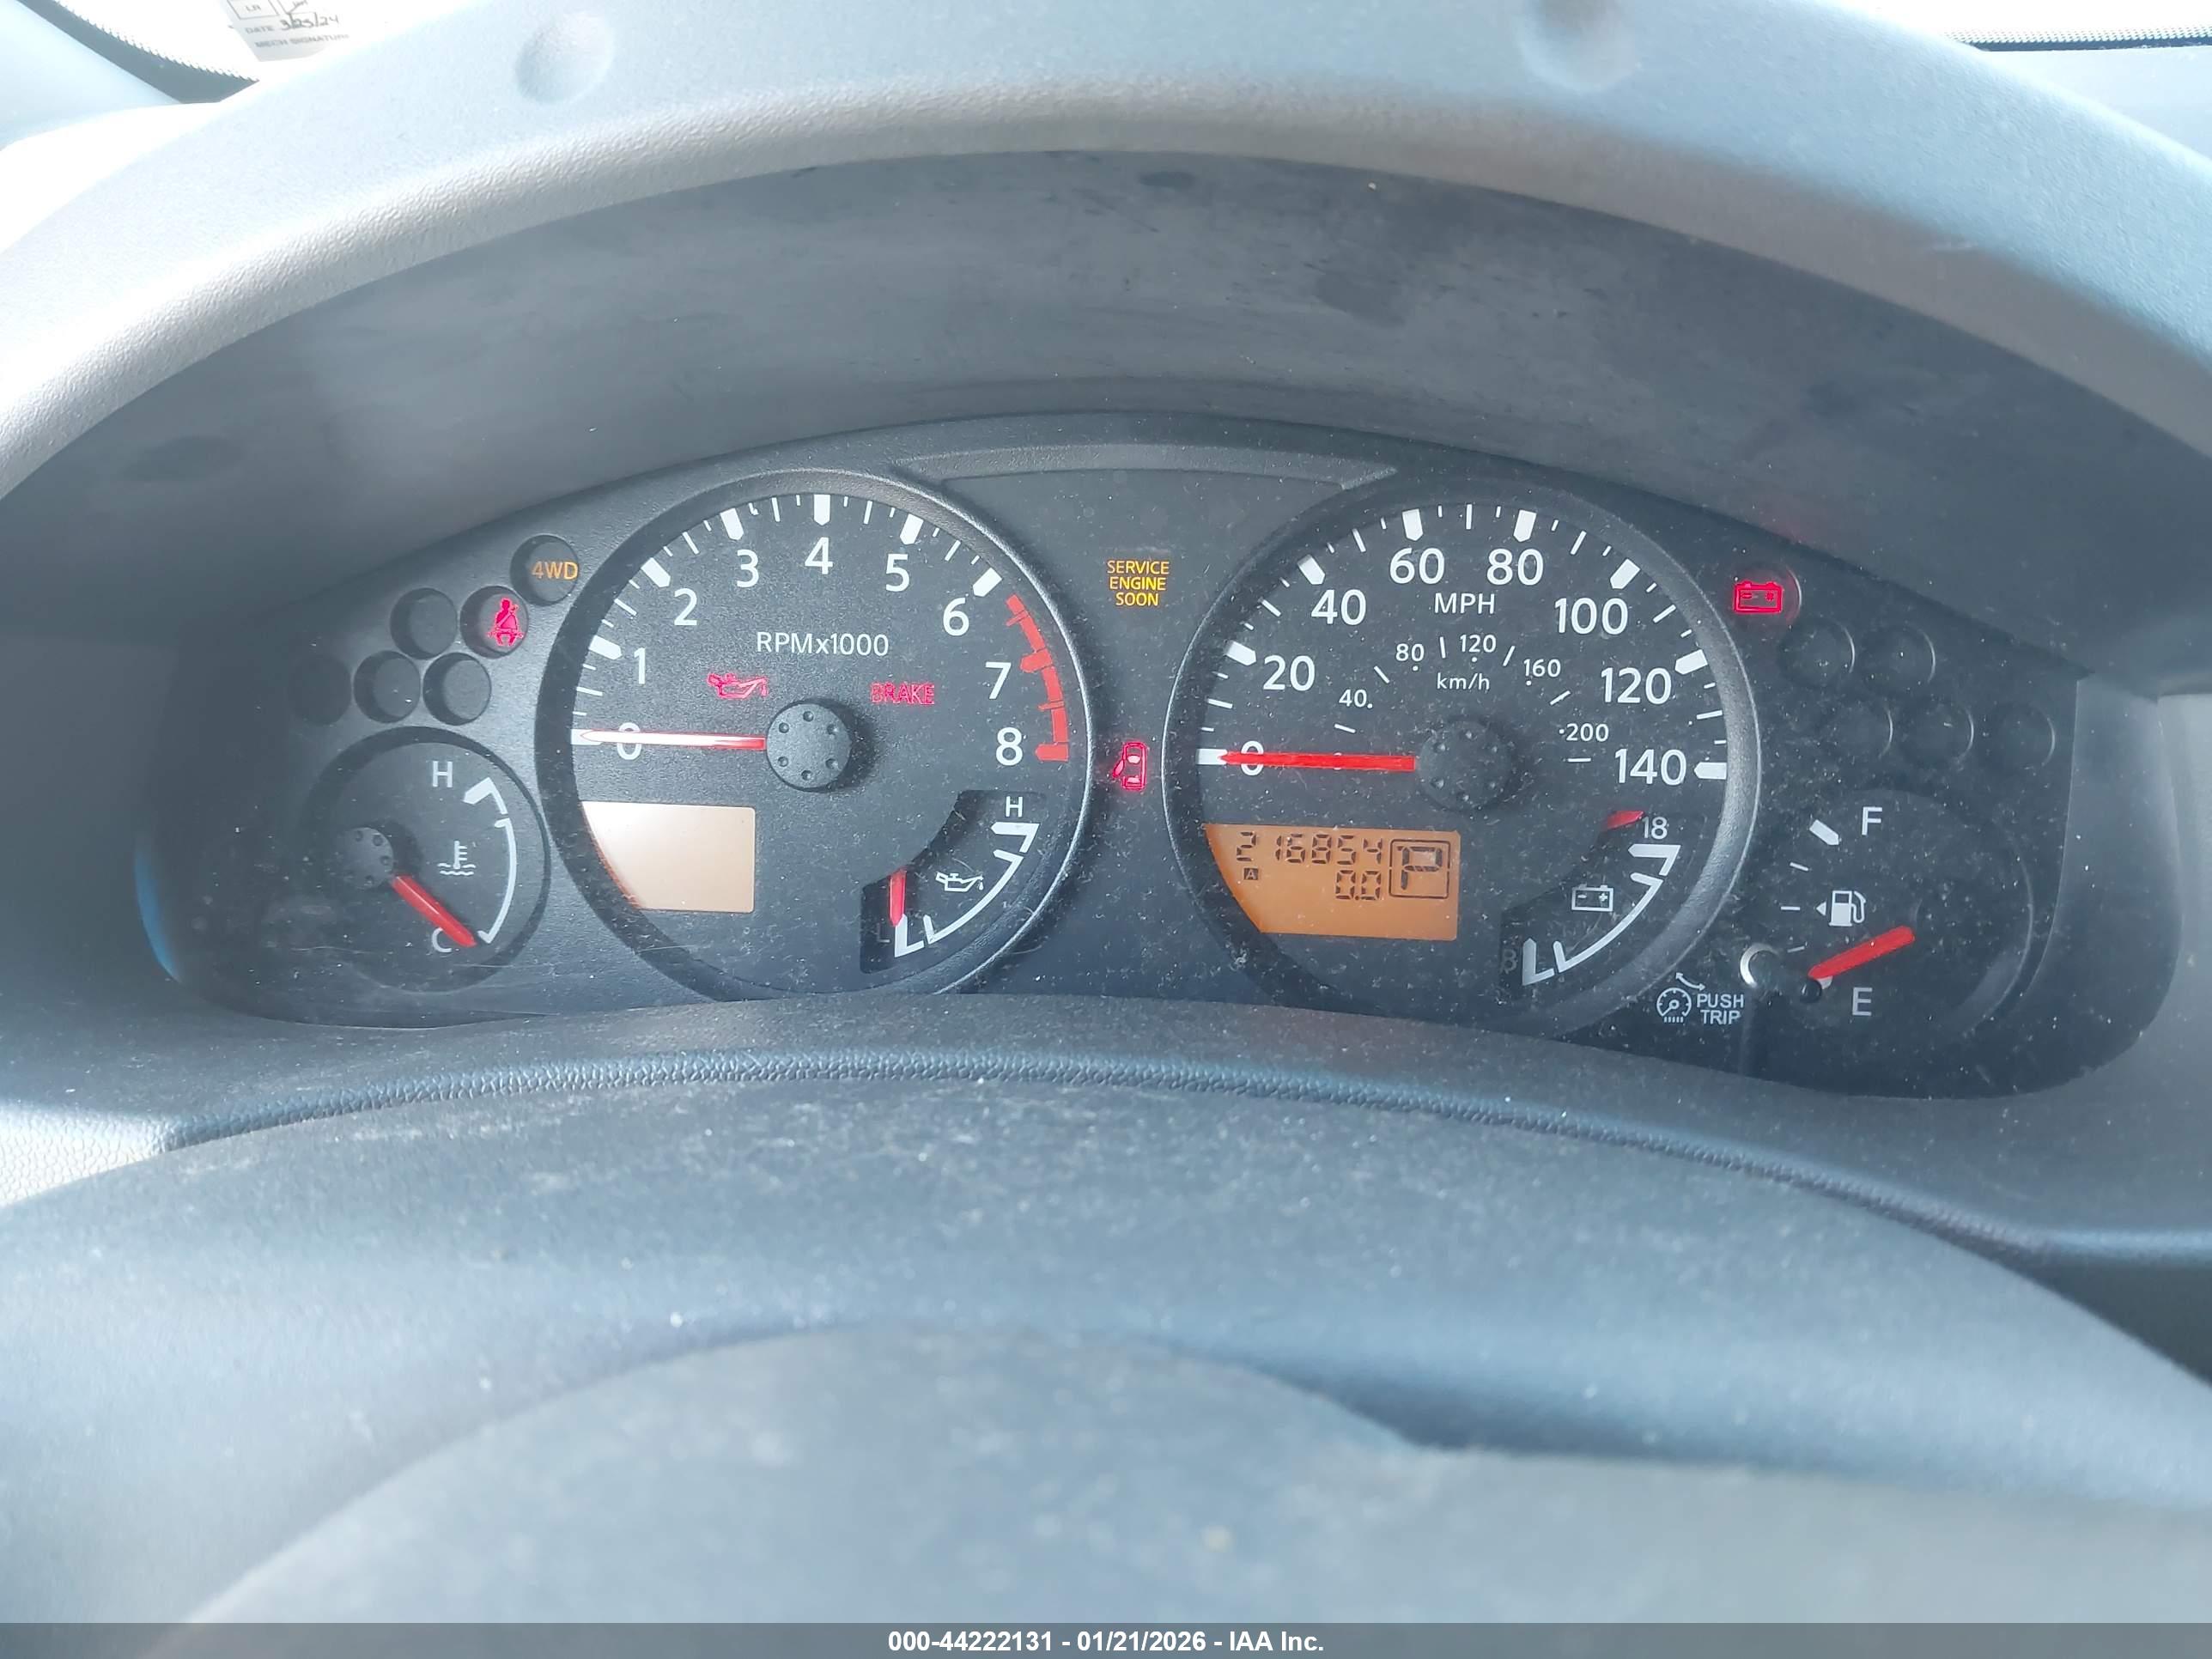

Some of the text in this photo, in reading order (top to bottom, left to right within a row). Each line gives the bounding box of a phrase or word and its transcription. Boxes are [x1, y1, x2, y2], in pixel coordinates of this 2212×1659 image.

[736, 550, 759, 587] 3
[805, 537, 833, 574] 4
[1107, 560, 1170, 574] SERVICE
[1389, 548, 1444, 584] 60
[1486, 548, 1543, 586] 80
[532, 561, 579, 581] 4WD
[884, 553, 909, 592] 5
[1109, 576, 1166, 590] ENGINE
[673, 589, 697, 626] 2
[1115, 592, 1158, 606] SOON
[1311, 589, 1365, 625] 40
[1434, 593, 1495, 615] MPH
[944, 598, 969, 635] 6
[1553, 598, 1629, 635] 100
[757, 632, 890, 656] RPMx1000
[1396, 643, 1425, 663] 80
[1460, 635, 1497, 653] 120
[633, 647, 646, 684] 1
[1263, 656, 1316, 690] 20
[1524, 659, 1561, 678] 160
[871, 683, 934, 705] BRAKE
[986, 661, 1011, 700] 7
[1437, 672, 1490, 691] km/h
[1601, 667, 1673, 704] 120
[1339, 690, 1367, 708] 40
[617, 722, 641, 760] 0
[996, 728, 1023, 765] 8
[1566, 723, 1609, 742] 200
[1241, 741, 1264, 775] 0
[1614, 748, 1686, 785] 140
[433, 761, 453, 787] H
[1006, 796, 1024, 817] H
[1862, 806, 1882, 835] F
[1644, 817, 1668, 839] 18
[1237, 831, 1382, 865] 216854
[1243, 867, 1259, 880] A
[1397, 846, 1443, 890] P
[1335, 870, 1381, 901] 0.0
[432, 928, 453, 953] C
[1697, 993, 1745, 1009] PUSH
[1852, 987, 1873, 1016] E
[1700, 1009, 1741, 1024] TRIP
